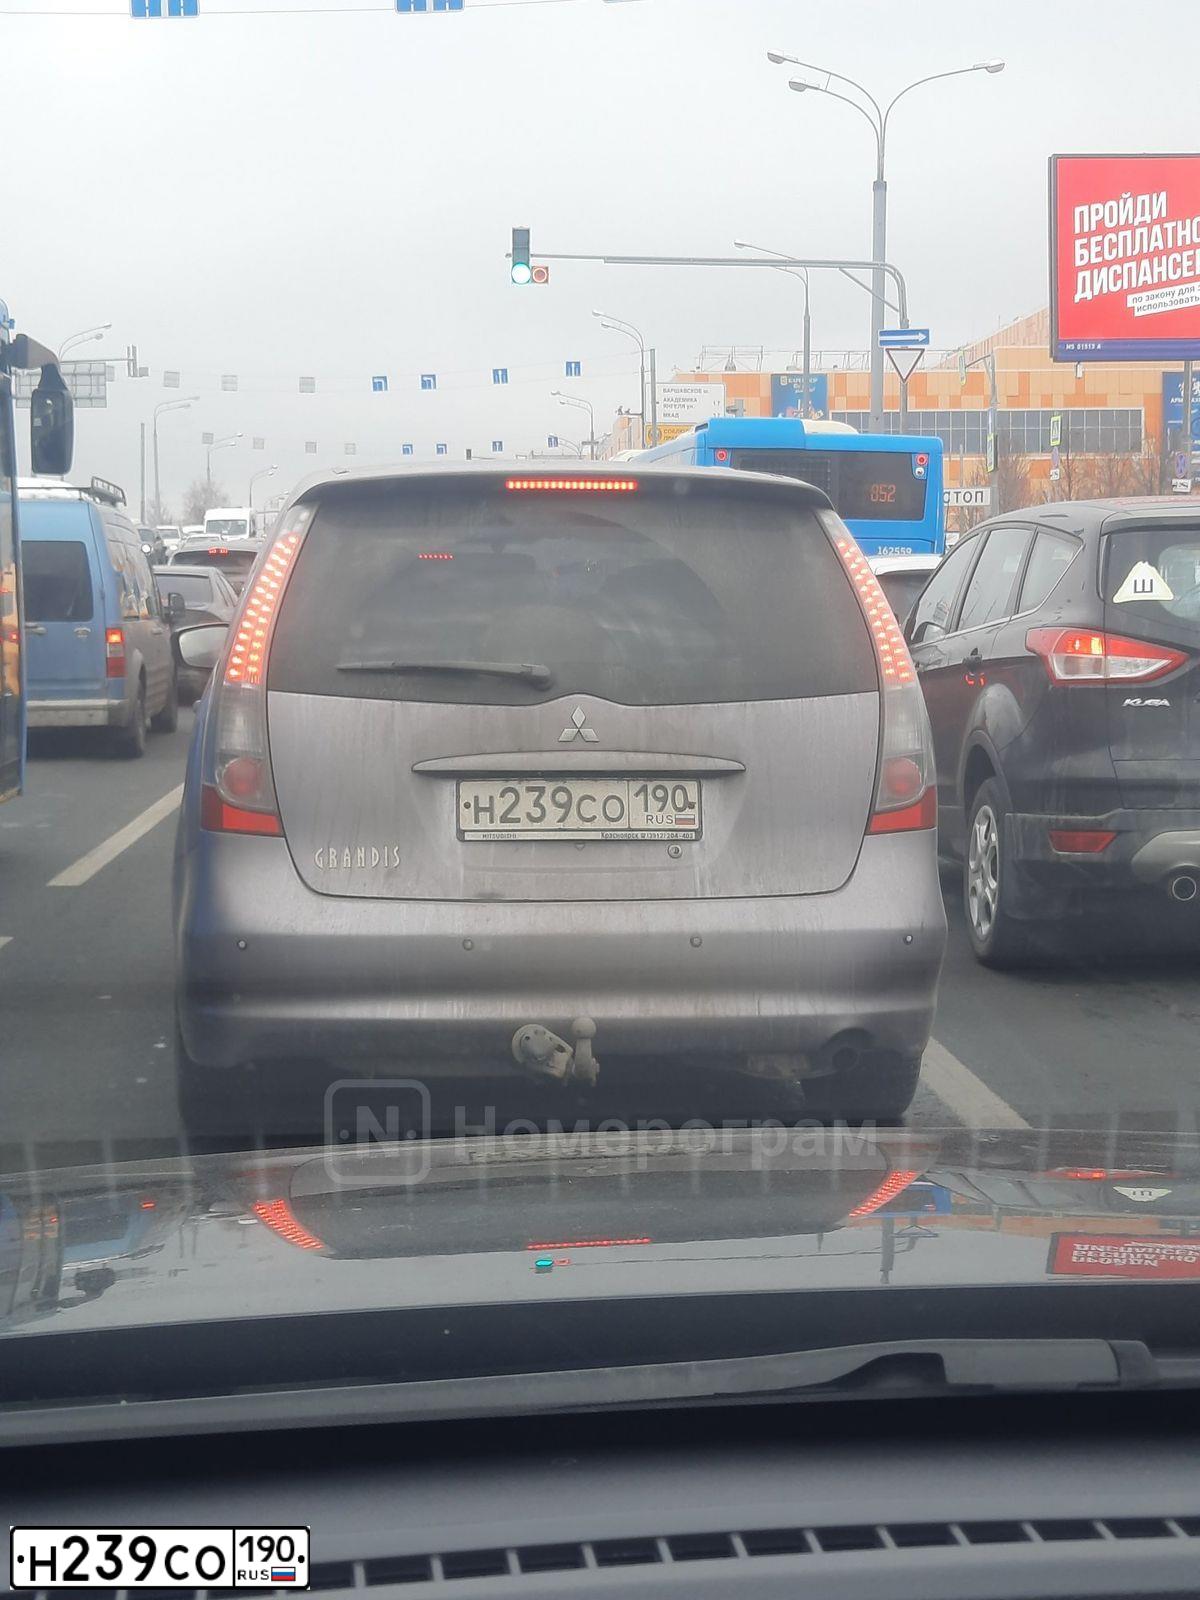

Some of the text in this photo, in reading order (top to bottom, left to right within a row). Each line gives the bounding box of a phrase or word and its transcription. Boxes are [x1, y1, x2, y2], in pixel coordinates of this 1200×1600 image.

[1074, 191, 1167, 235] ПРОЙДИ
[1132, 296, 1143, 304] по
[1145, 290, 1176, 302] закону
[1177, 286, 1195, 297] для
[1136, 295, 1200, 312] использовать
[943, 490, 984, 504] СТОП
[877, 545, 912, 555] 162559
[1134, 579, 1153, 593] Ш
[1122, 698, 1171, 707] KUGA
[473, 783, 688, 824] Н239СО 190
[646, 814, 674, 825] RUS
[314, 846, 400, 869] GRANDIS
